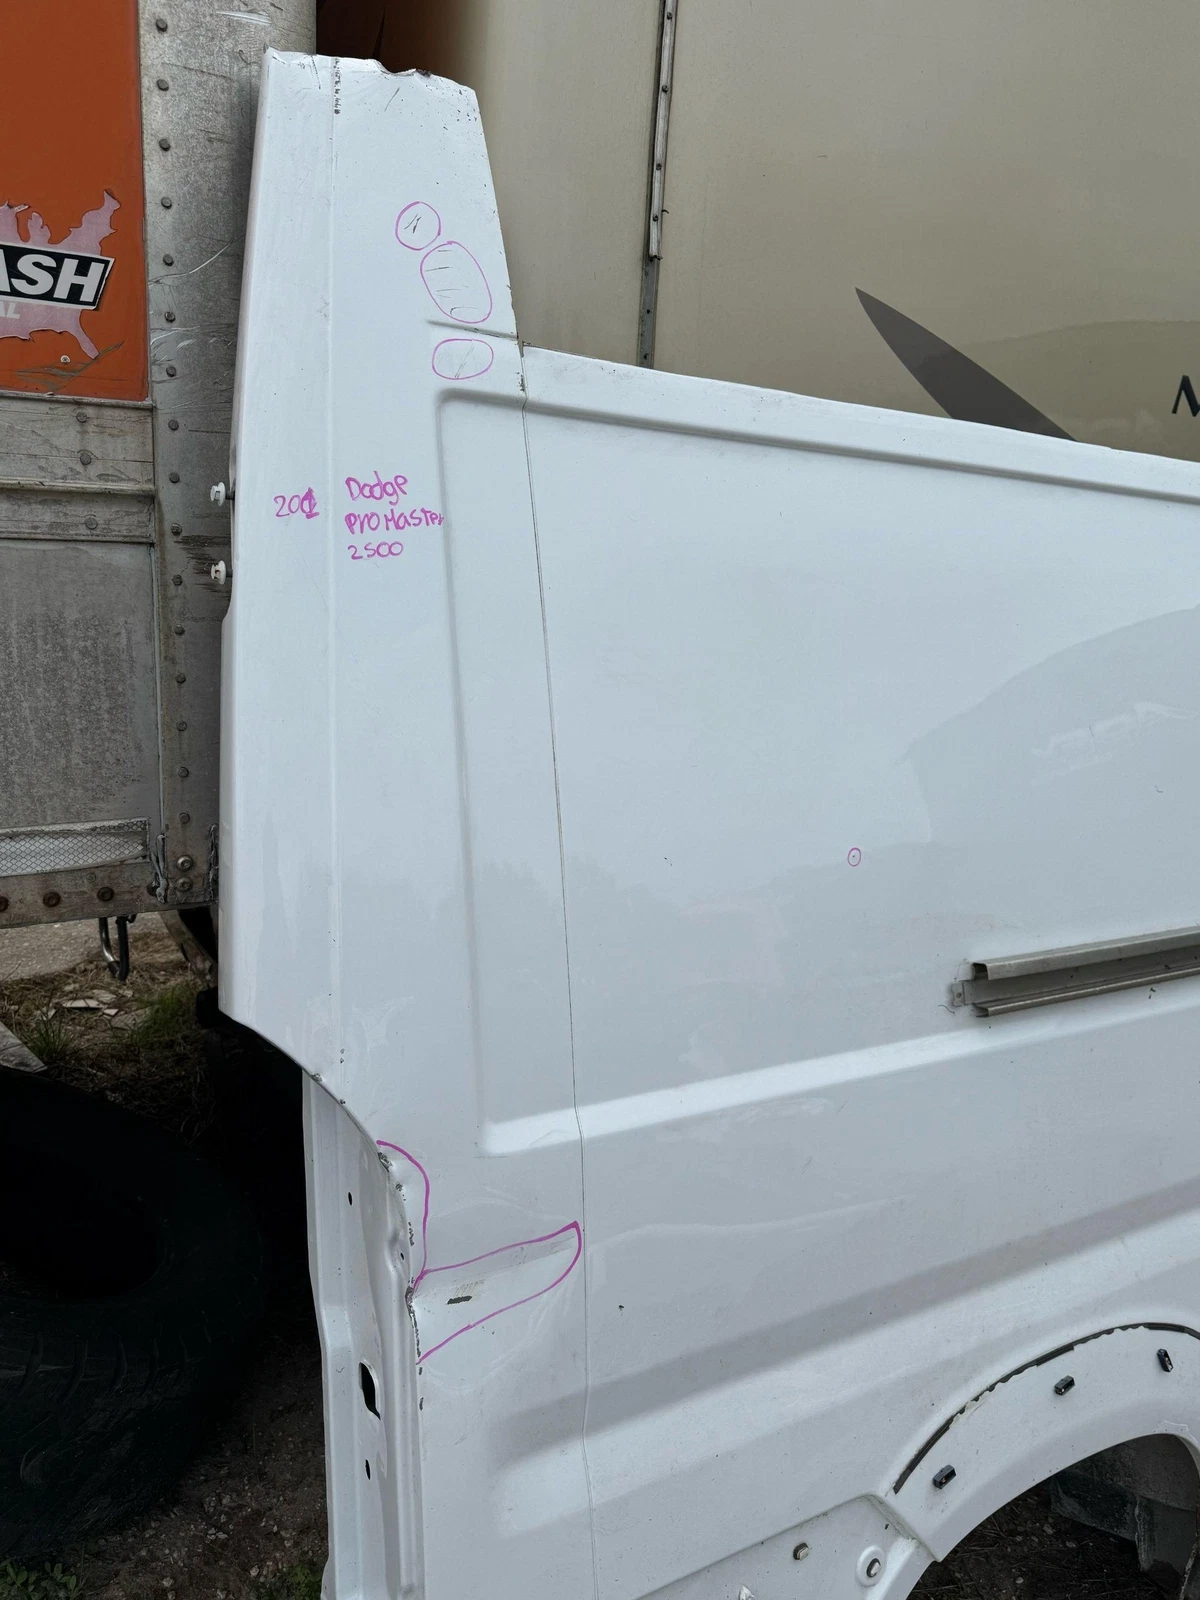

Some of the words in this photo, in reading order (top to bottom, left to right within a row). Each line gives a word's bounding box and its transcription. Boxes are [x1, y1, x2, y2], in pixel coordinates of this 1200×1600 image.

[0, 248, 105, 303] SH
[345, 470, 408, 506] Dodge
[348, 541, 404, 560] 2500
